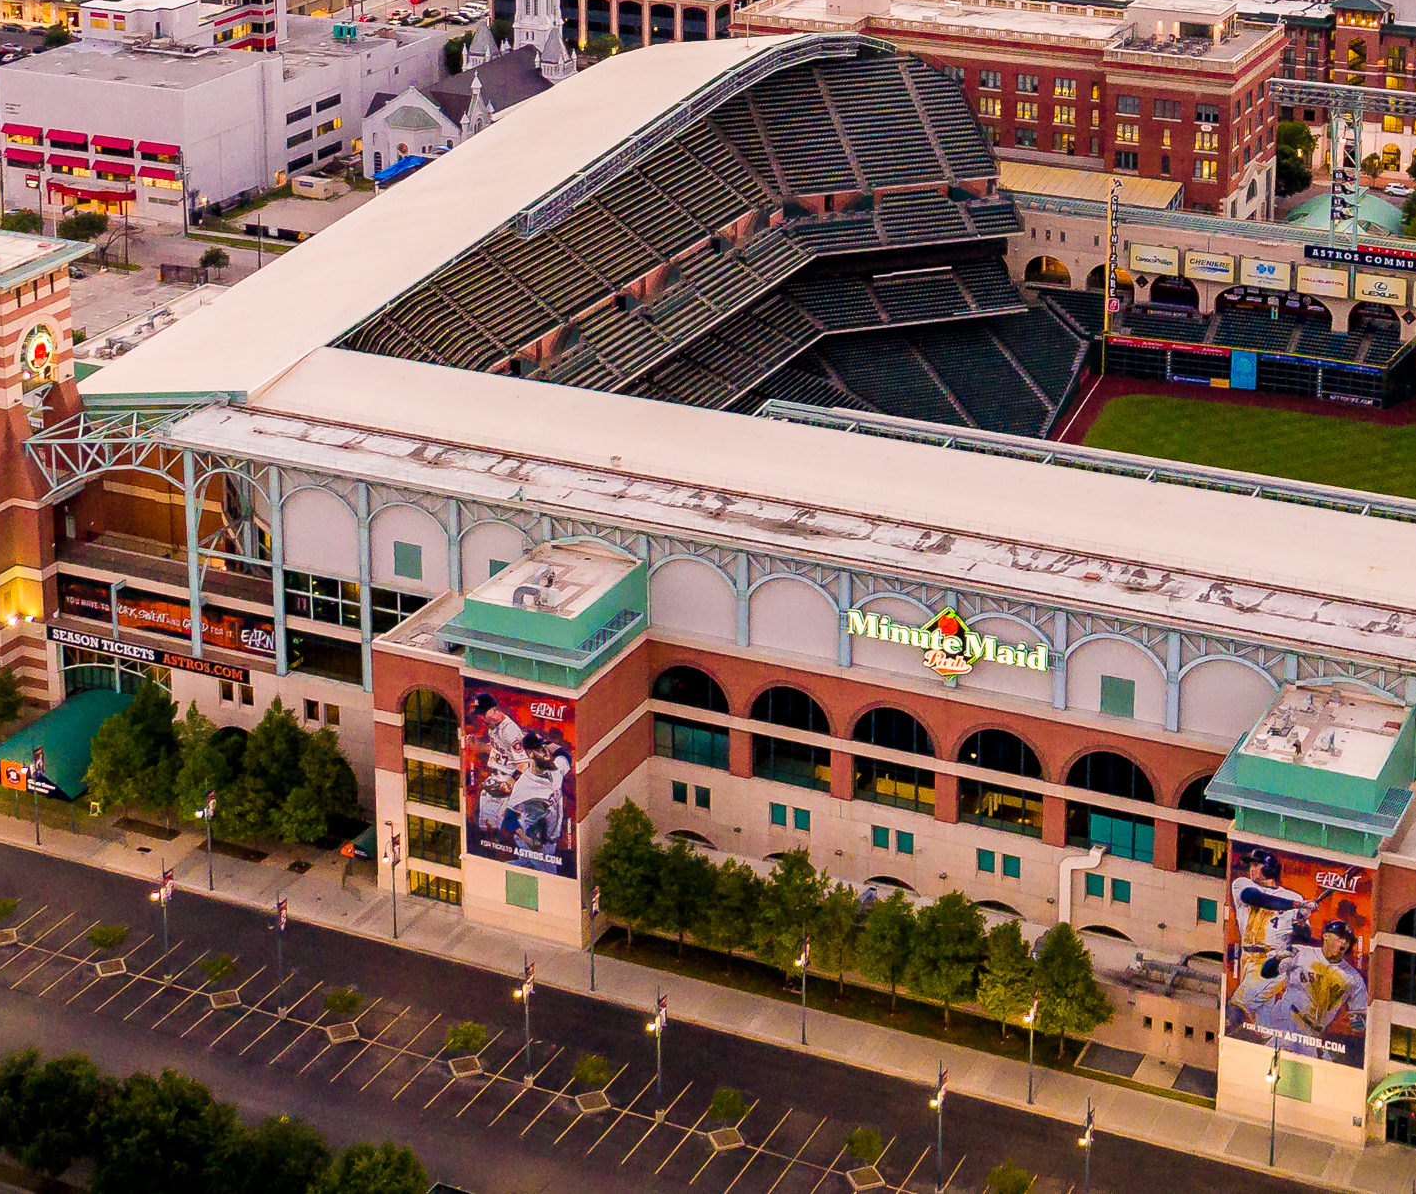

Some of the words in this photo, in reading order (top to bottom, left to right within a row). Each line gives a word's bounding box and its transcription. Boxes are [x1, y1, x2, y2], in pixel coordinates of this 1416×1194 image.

[1189, 258, 1231, 269] CHENIERE
[1312, 248, 1359, 262] ASTROS
[1361, 289, 1399, 300] LEXUS
[847, 609, 962, 654] Minute
[963, 631, 1049, 672] Maid
[52, 628, 100, 648] SEASON
[101, 639, 156, 661] TICKETS
[162, 653, 244, 681] ASTROS.COM
[923, 649, 970, 670] Park
[513, 846, 563, 866] ASTROS.COM
[1269, 916, 1280, 929] 4
[1284, 1031, 1347, 1054] ASTROS.COM
